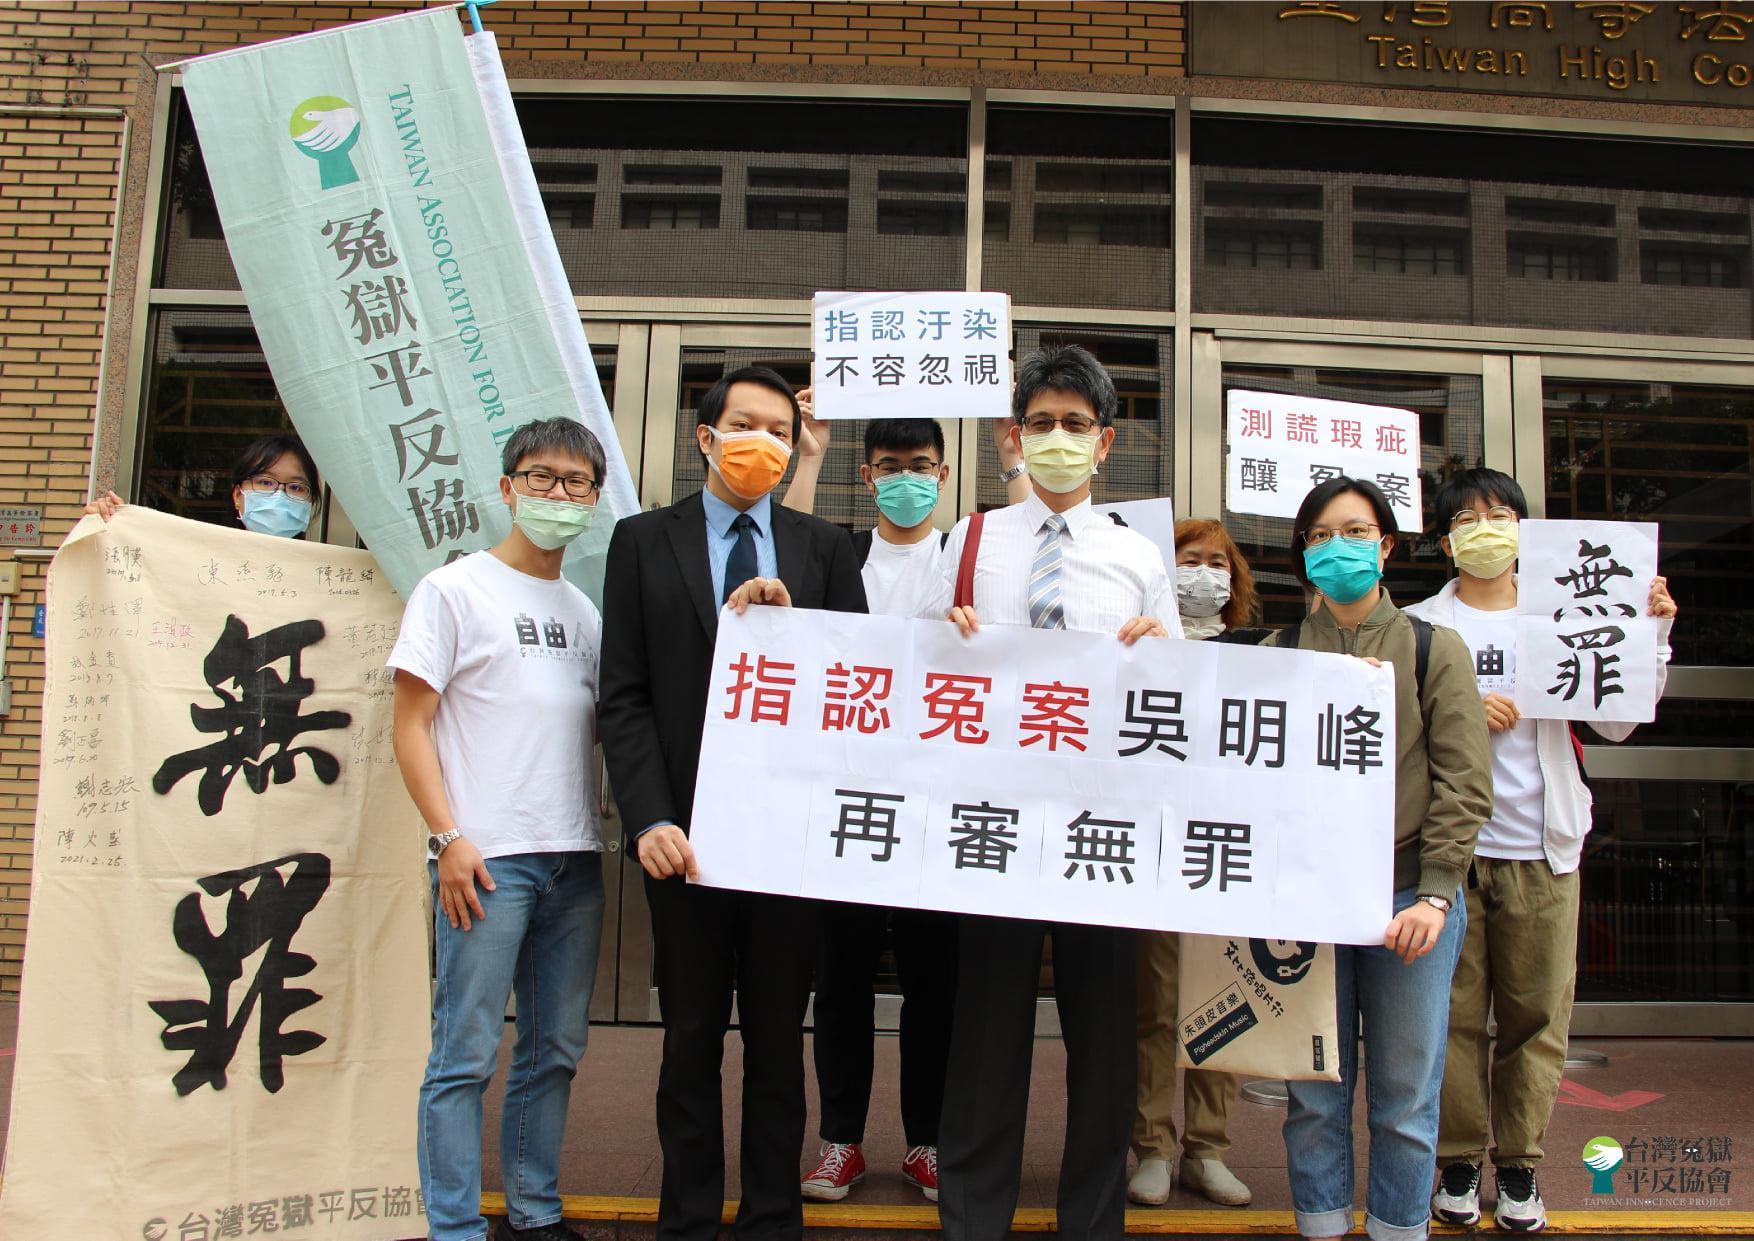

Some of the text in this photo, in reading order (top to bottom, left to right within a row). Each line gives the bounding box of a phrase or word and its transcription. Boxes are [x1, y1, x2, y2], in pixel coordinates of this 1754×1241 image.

[1367, 35, 1528, 75] Taiwan
[1560, 45, 1660, 90] High
[388, 83, 434, 188] TAIWAN
[416, 194, 488, 364] ASSOCIATION
[472, 367, 506, 423] FOR
[824, 353, 1000, 387] 不容忽視
[1240, 407, 1408, 455] 測謊瑕疵
[1546, 539, 1638, 711] 無罪
[1477, 643, 1516, 675] 由
[724, 652, 1385, 776] 指認冤案吳明峰
[148, 613, 353, 1098] 無罪
[830, 788, 1253, 893] 再審無罪
[1184, 992, 1240, 1038] 朱頭皮音樂
[1193, 1012, 1250, 1057] Pigheadskin Music
